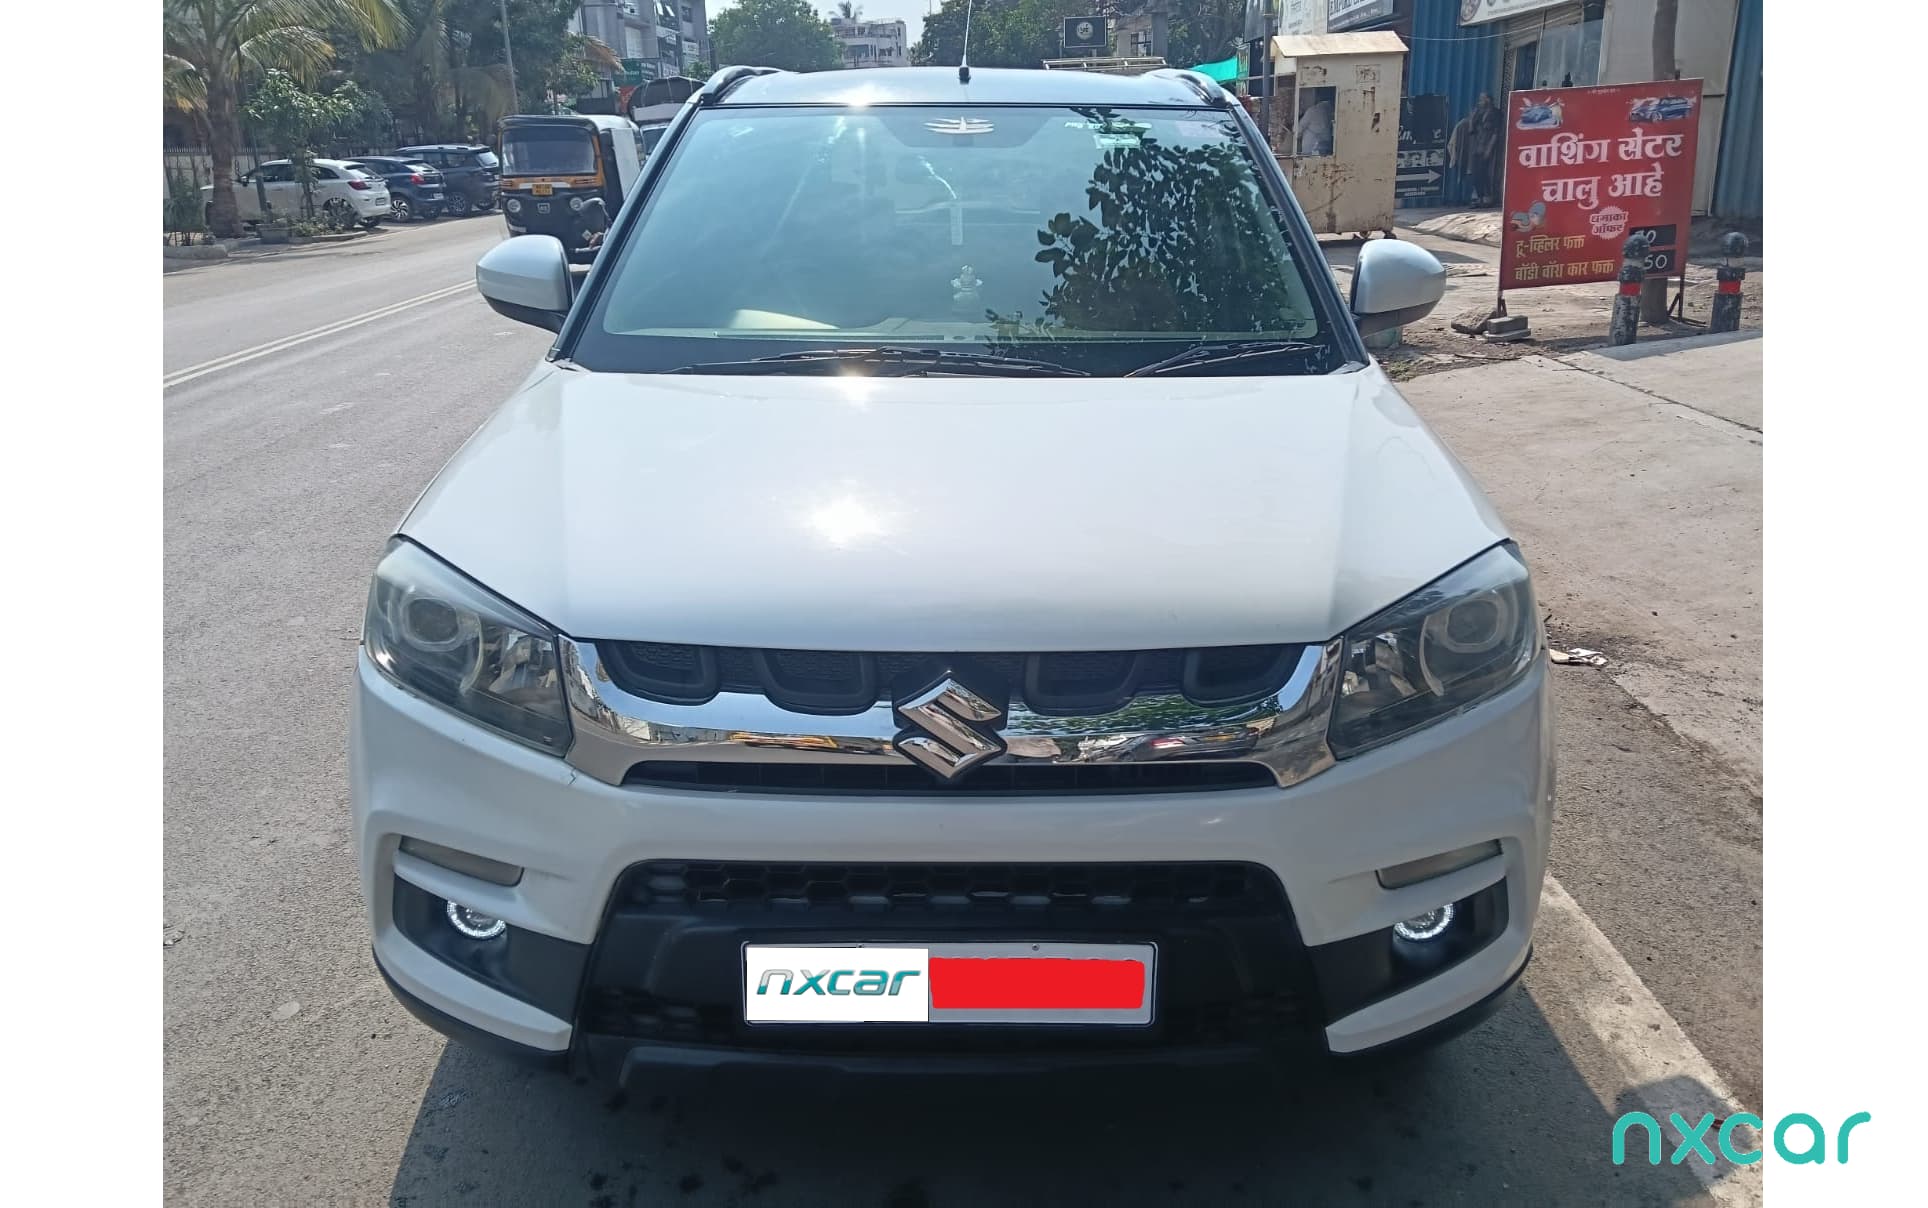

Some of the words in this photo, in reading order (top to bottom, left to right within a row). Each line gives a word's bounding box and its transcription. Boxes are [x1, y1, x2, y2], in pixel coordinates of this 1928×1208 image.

[1518, 132, 1611, 168] वाशिंग
[1541, 175, 1601, 210] चालु
[1608, 162, 1664, 197] आहे
[1567, 261, 1588, 276] कार
